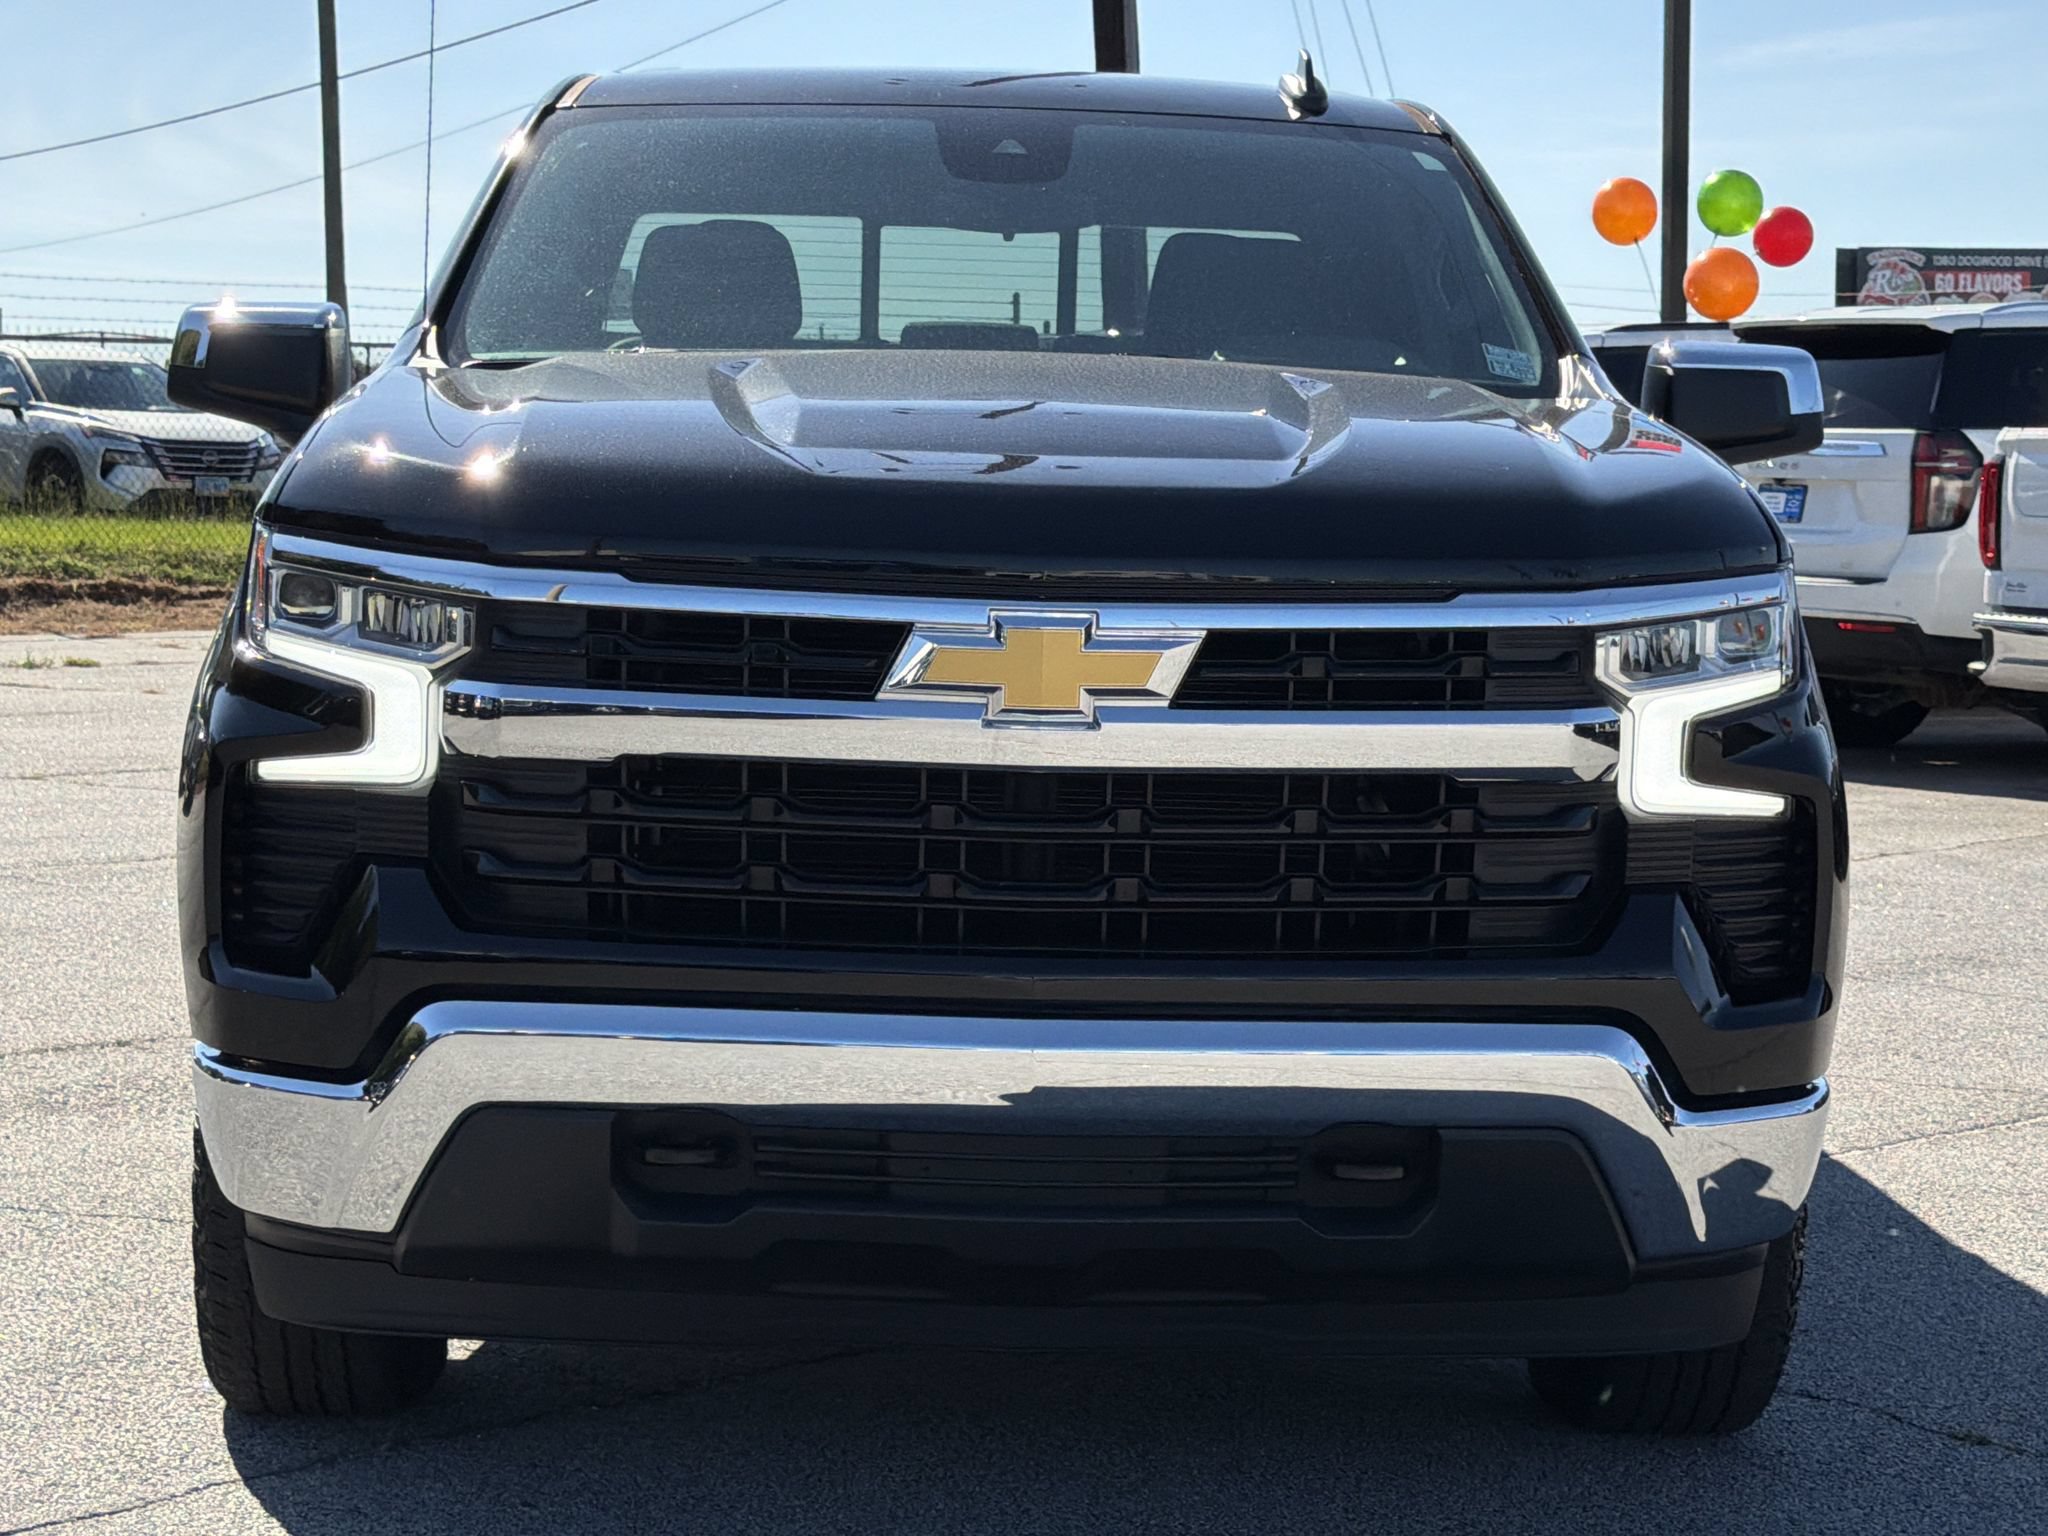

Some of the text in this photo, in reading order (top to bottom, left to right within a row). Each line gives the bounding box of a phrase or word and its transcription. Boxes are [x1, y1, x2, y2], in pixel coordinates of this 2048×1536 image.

[1957, 255, 2013, 267] DOGWOOD
[2014, 255, 2042, 267] DRIVE
[1935, 273, 1954, 293] 60
[1958, 273, 2022, 294] FLAVORS
